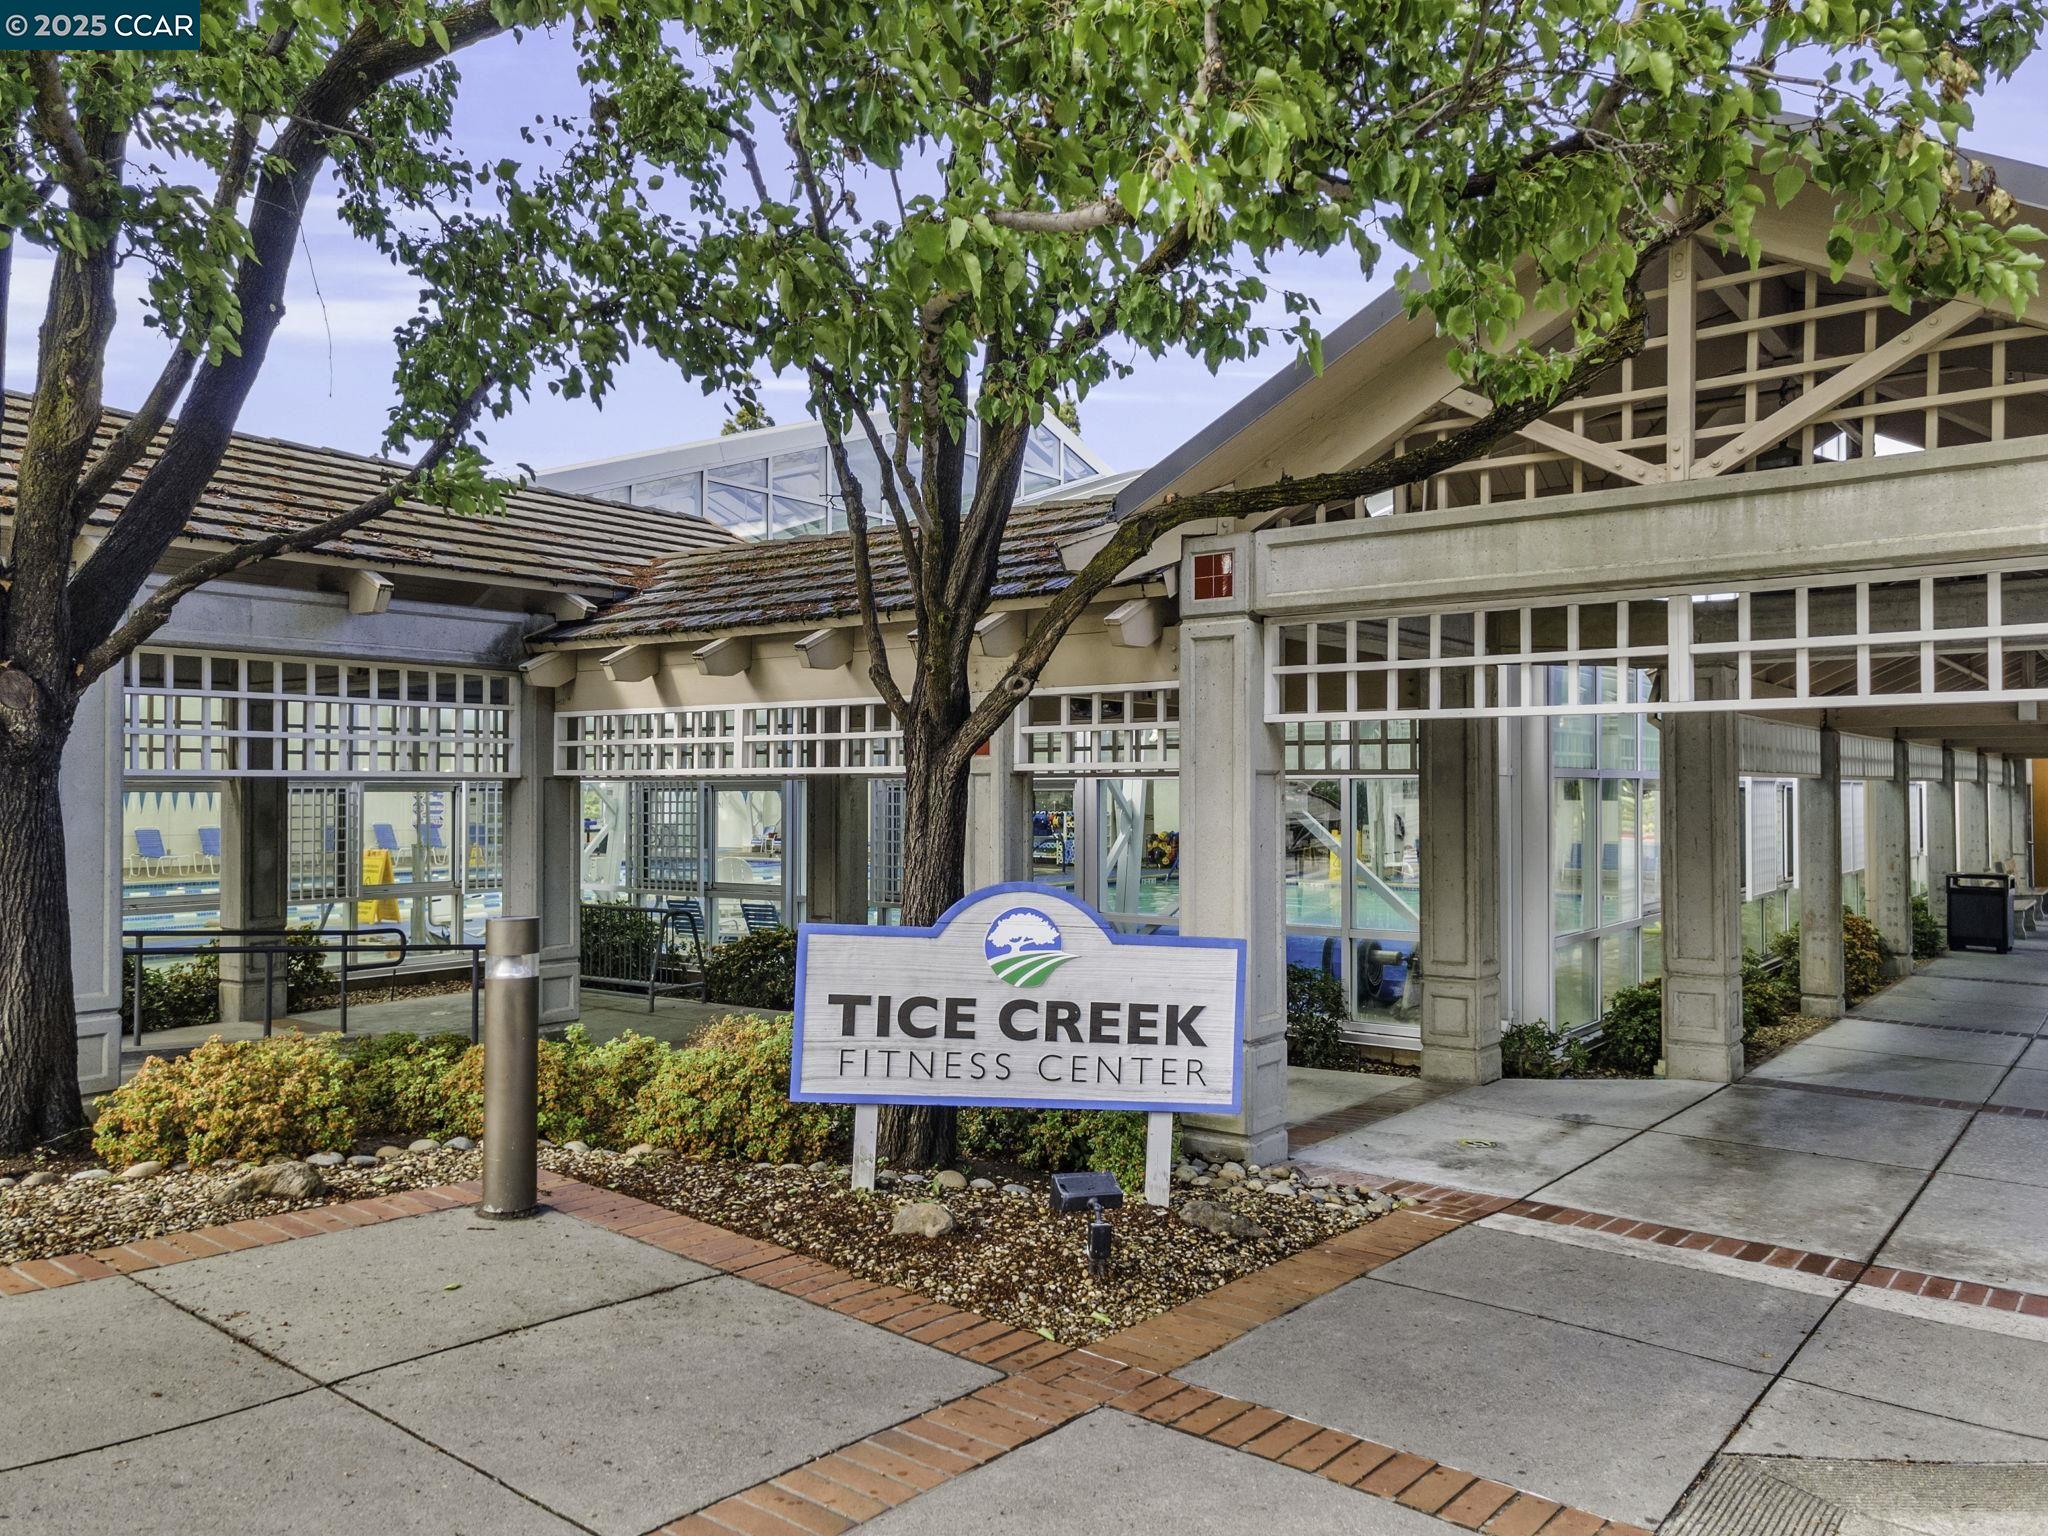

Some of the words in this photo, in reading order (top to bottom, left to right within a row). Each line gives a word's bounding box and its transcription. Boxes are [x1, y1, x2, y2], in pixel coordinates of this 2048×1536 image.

[827, 993, 977, 1040] TICE
[998, 998, 1208, 1048] CREEK
[839, 1048, 1012, 1081] FITNESS
[1037, 1054, 1208, 1087] CENTER
